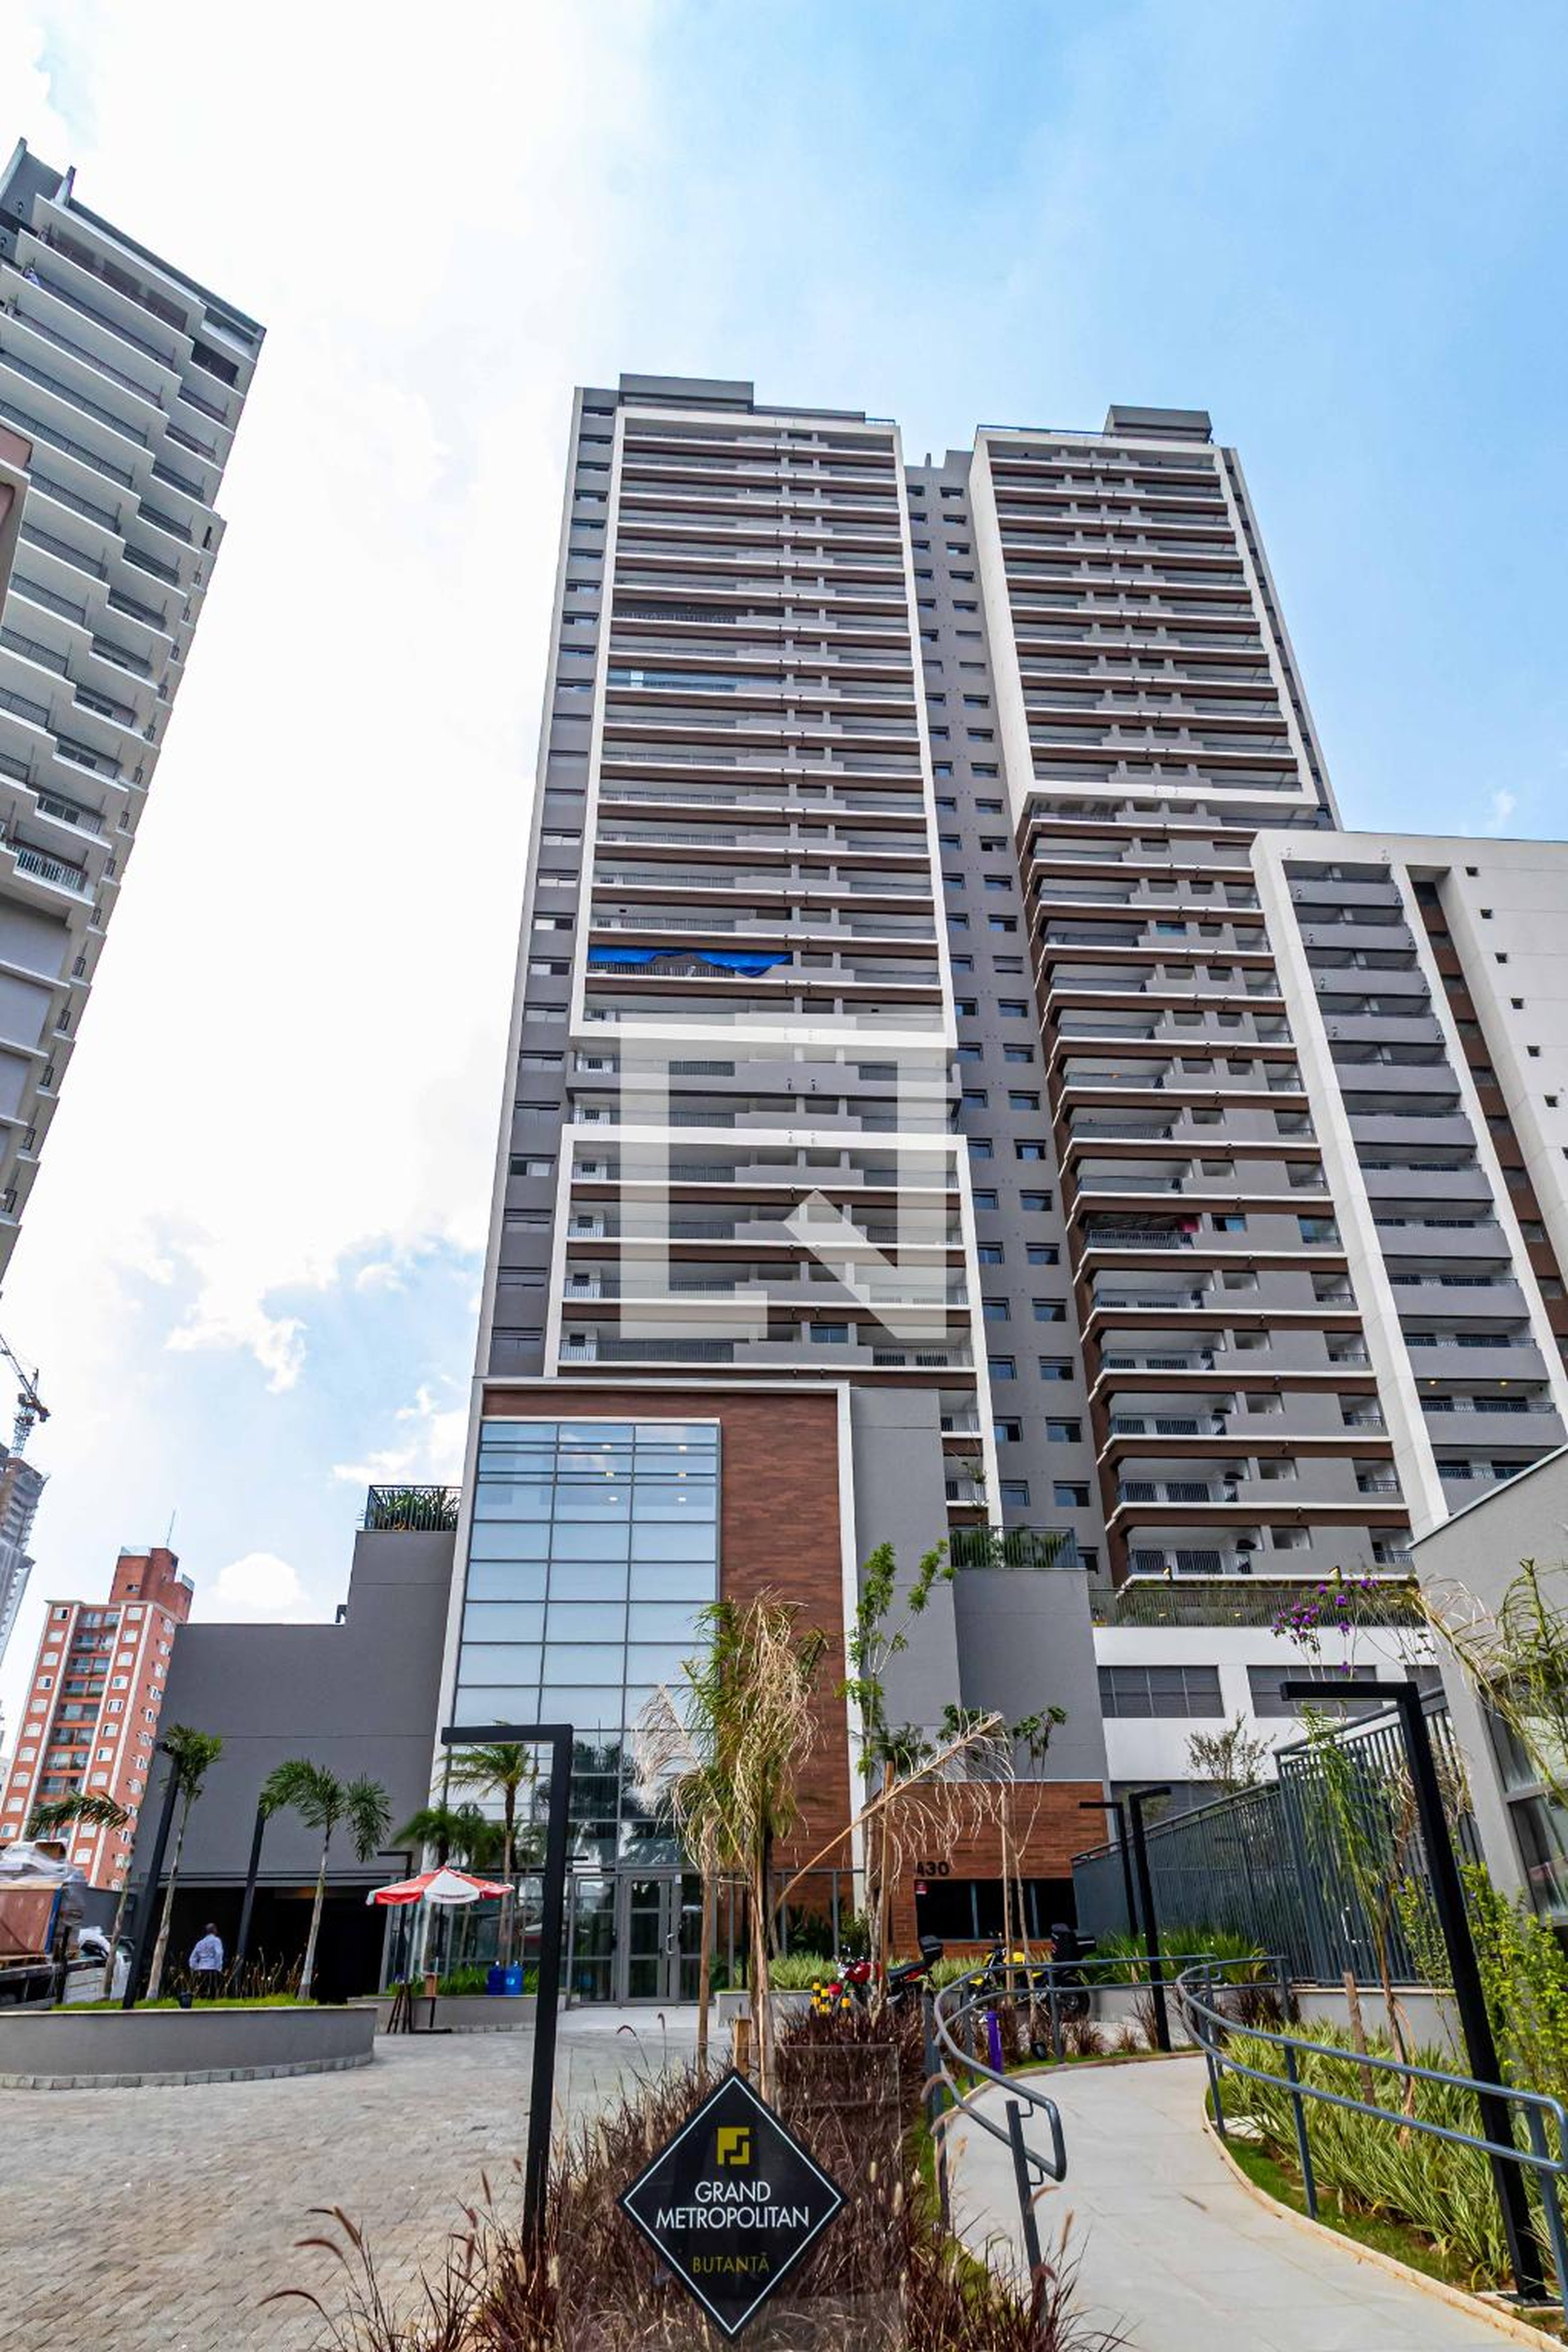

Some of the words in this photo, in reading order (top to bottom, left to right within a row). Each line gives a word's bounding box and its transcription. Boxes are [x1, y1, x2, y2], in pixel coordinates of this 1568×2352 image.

[695, 2181, 771, 2203] GRAND
[655, 2207, 809, 2229] METROPOLITAN
[693, 2252, 770, 2274] BUTANTÃ
